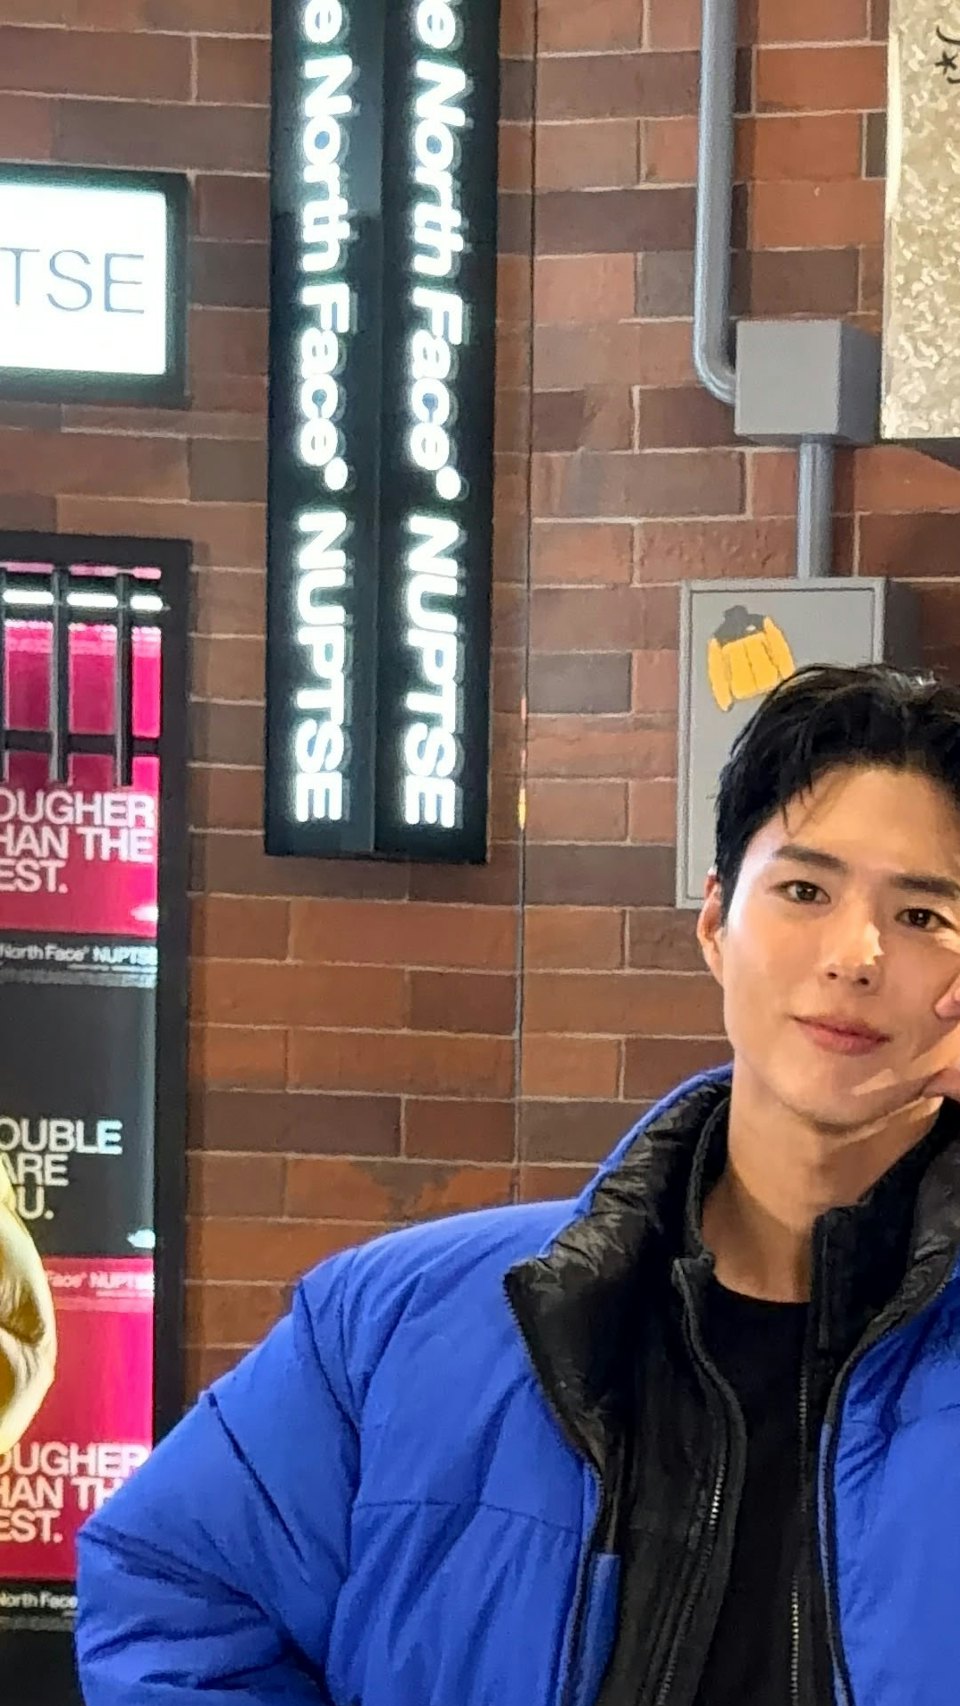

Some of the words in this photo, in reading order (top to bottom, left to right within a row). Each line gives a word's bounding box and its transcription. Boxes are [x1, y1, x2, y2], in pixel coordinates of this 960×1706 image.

[302, 55, 353, 272] North
[413, 58, 466, 277] North
[0, 246, 145, 315] TSE
[296, 511, 347, 823] NUPTSE
[404, 514, 459, 828] NUPTSE
[76, 826, 154, 863] THE
[71, 1475, 124, 1511] TH
